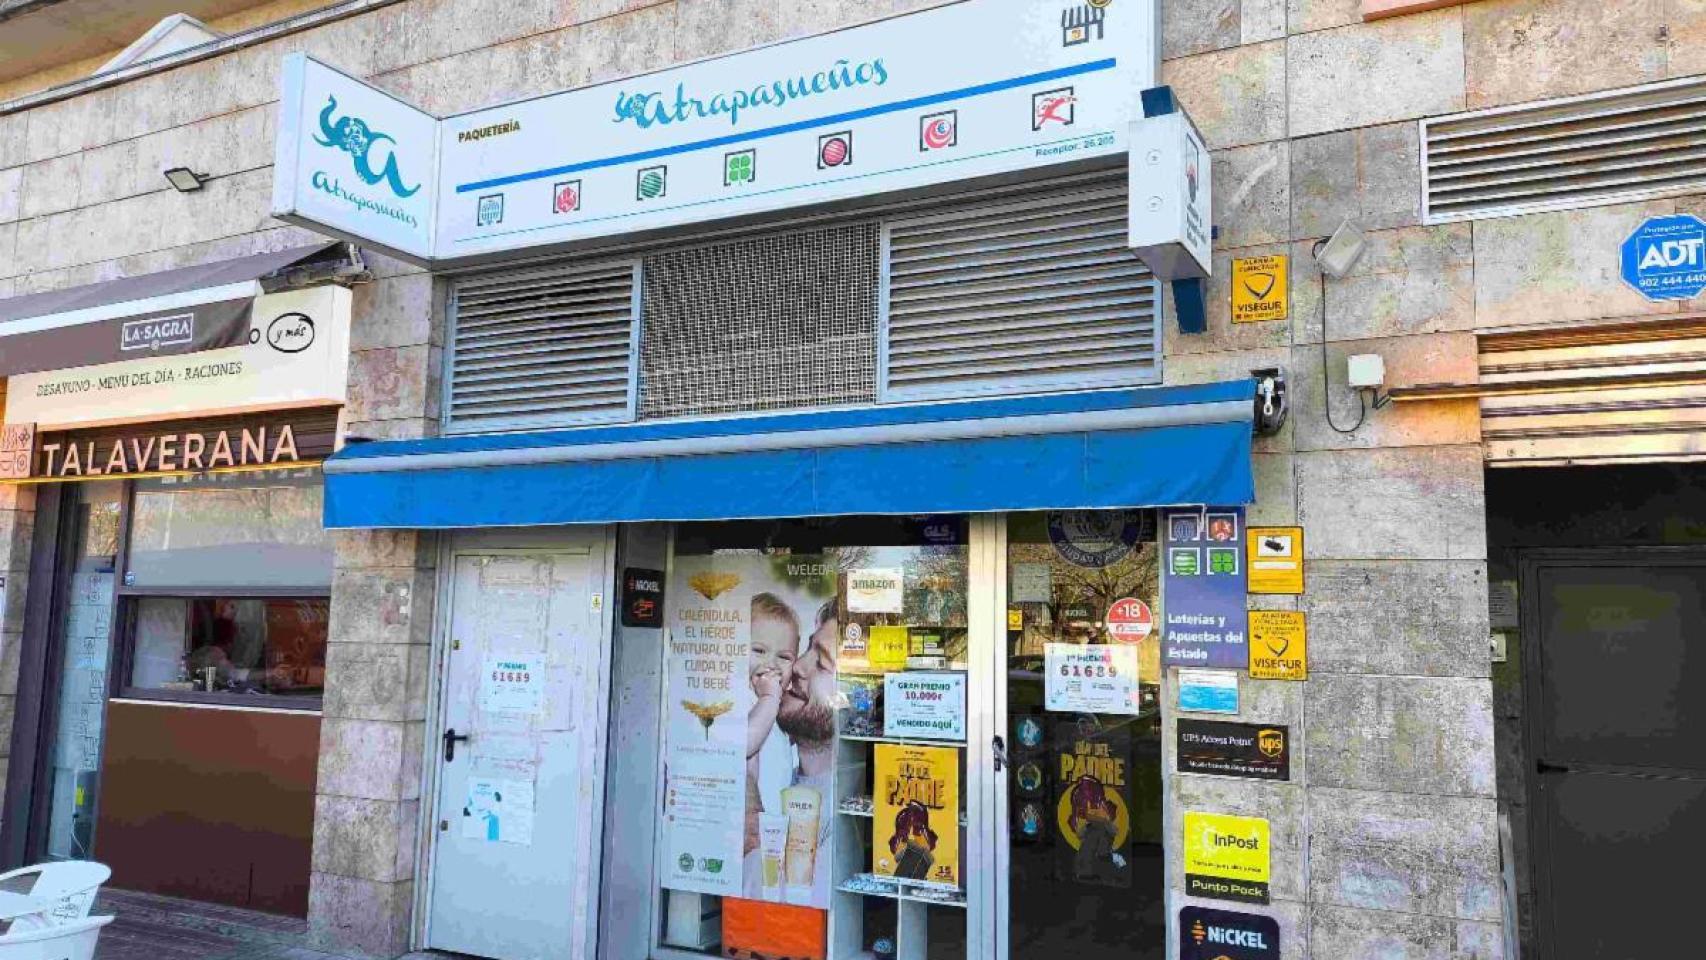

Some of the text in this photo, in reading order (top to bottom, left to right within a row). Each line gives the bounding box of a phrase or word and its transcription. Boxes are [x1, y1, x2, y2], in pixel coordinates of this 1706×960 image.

[458, 119, 521, 143] PAQUETERÍA
[1639, 238, 1704, 269] ADT
[1639, 277, 1659, 288] 902
[1662, 275, 1682, 285] 444
[1237, 301, 1282, 312] VISEGUR
[36, 379, 91, 397] DESAYUNO
[131, 372, 152, 387] DEL
[154, 368, 175, 382] DÍA
[185, 361, 243, 381] RACIONES
[42, 424, 299, 477] TALAVERANA
[851, 579, 895, 590] amazon
[1118, 602, 1141, 618] +18
[1168, 612, 1226, 628] Loterías y
[685, 624, 736, 640] EL HÉROE
[1168, 630, 1243, 644] Apuestas del
[672, 641, 747, 657] NATURAL QUE
[1168, 648, 1208, 660] Estado
[685, 660, 734, 673] CUIDA DE
[1253, 658, 1302, 669] VISEGUR
[492, 671, 530, 683] 61689
[1060, 665, 1116, 678] 61689
[687, 675, 730, 690] TU BEBÉ
[898, 682, 951, 691] GRAN PREMIO
[896, 719, 952, 730] VENDIDO AQUÍ
[1182, 733, 1200, 743] UPS
[1201, 734, 1228, 745] Access
[1262, 737, 1281, 753] ups
[1060, 752, 1126, 785] PADRE
[1214, 833, 1259, 850] InPost
[1192, 879, 1263, 897] Punto Pack
